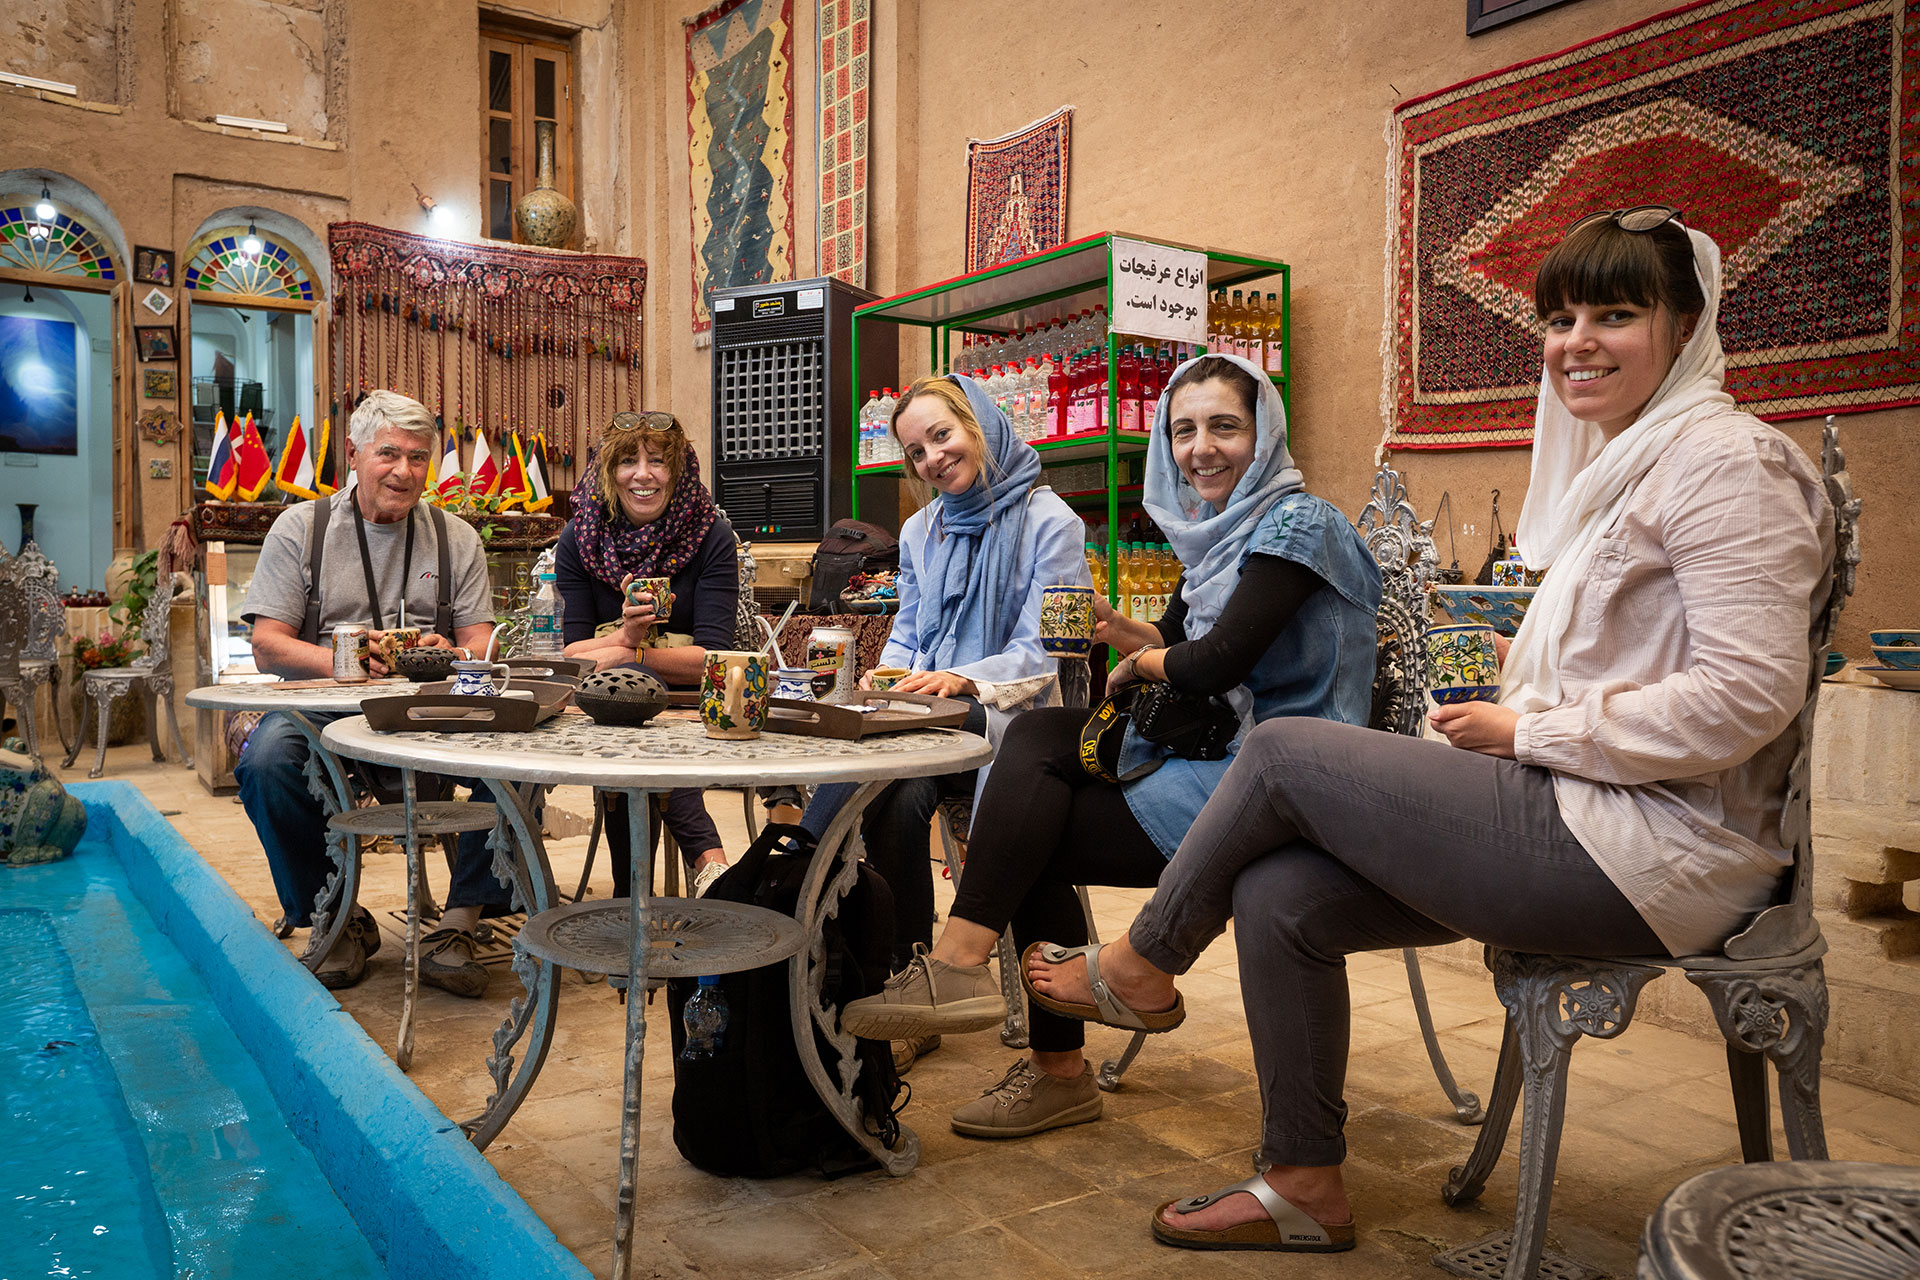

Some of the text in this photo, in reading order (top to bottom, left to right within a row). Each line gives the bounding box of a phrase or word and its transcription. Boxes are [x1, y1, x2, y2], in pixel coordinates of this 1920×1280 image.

[1119, 257, 1203, 289] انواع عرقیجات
[1159, 299, 1198, 321] موجود
